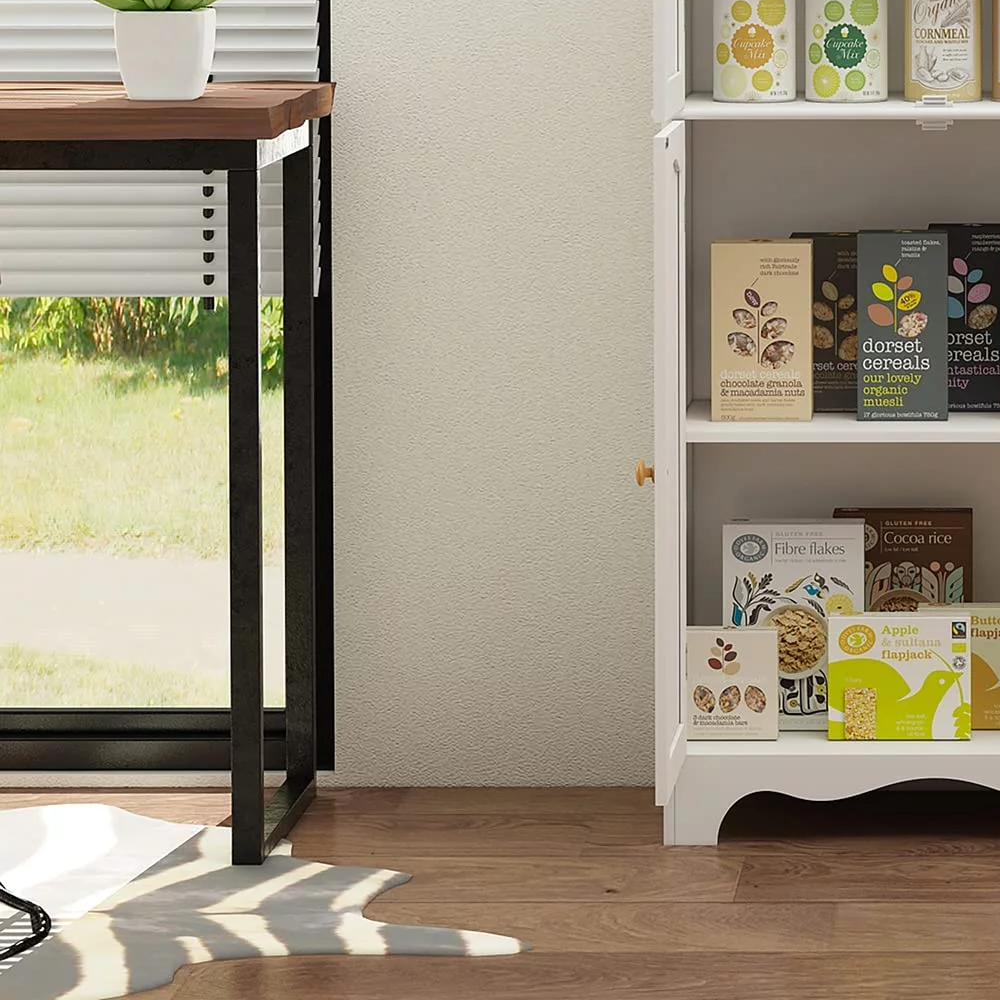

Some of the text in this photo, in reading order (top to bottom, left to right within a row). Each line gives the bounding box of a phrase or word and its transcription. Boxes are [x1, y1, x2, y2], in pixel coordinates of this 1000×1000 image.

[914, 28, 970, 39] CORNMEAL
[733, 38, 771, 50] Cupcake
[826, 38, 864, 50] Cupcake
[744, 48, 767, 60] Mix
[836, 48, 860, 60] Mix
[948, 331, 993, 345] orset
[862, 338, 923, 353] dorset
[948, 347, 999, 362] ereals
[862, 355, 930, 370] cereals
[720, 370, 801, 379] dorset cereals
[863, 373, 922, 384] our lovely
[720, 379, 803, 389] chocolate granola
[720, 389, 805, 397] & macadamia nuts
[863, 385, 908, 396] organic
[863, 397, 904, 407] muesli
[884, 531, 952, 545] Cocoa rice
[775, 542, 845, 555] Fibre flakes
[881, 625, 919, 636] Apple
[881, 639, 942, 647] & sultana
[881, 650, 932, 661] flapjack
